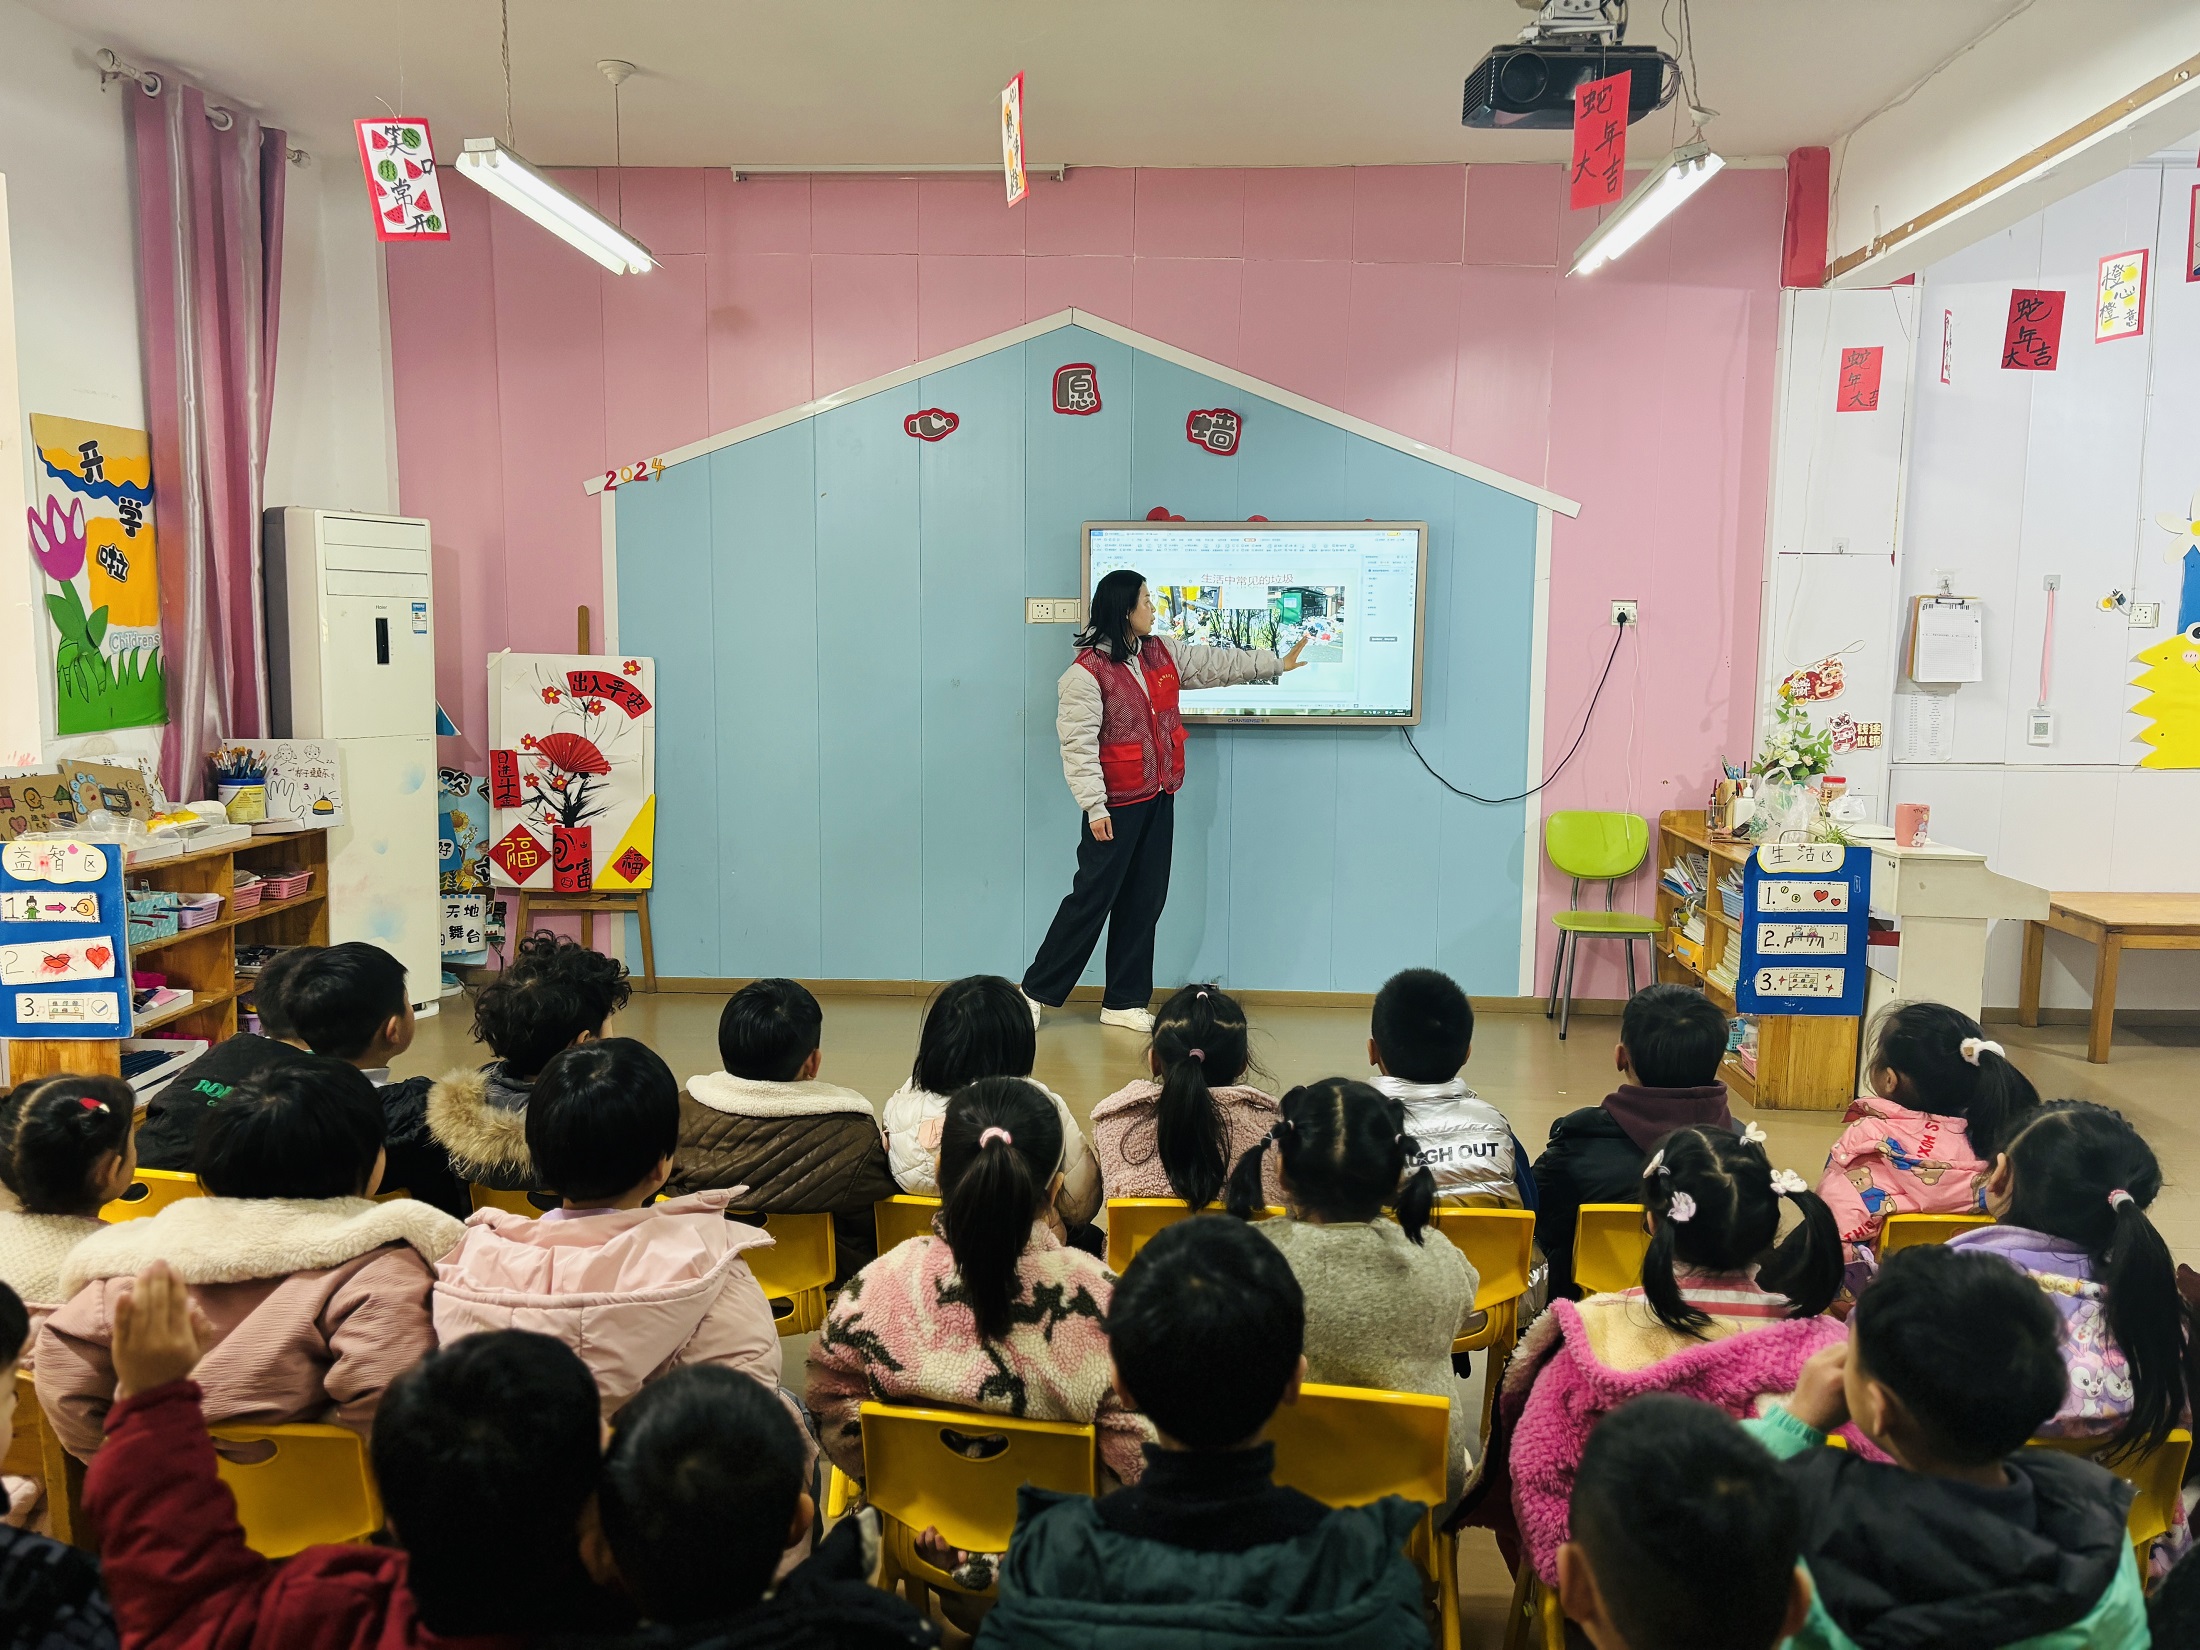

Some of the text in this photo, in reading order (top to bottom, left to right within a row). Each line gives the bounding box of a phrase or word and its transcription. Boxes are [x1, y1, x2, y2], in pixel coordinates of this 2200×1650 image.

[1573, 85, 1623, 194] 蛇年大吉
[385, 125, 434, 236] 笑口常开
[2100, 262, 2136, 328] 橙心橙意
[2003, 298, 2053, 368] 蛇年大吉
[1843, 349, 1879, 407] 蛇年大吉
[603, 457, 666, 491] 2024
[1201, 573, 1294, 587] 生活中常见的垃圾
[110, 633, 160, 650] Childrens
[572, 671, 645, 714] 出入平安
[497, 751, 520, 807] 日进斗金
[12, 845, 97, 872] 益智区
[501, 837, 537, 870] 福
[622, 850, 644, 878] 福
[1770, 845, 1833, 865] 生活区
[446, 904, 480, 918] 天地
[1458, 1142, 1499, 1160] OUT
